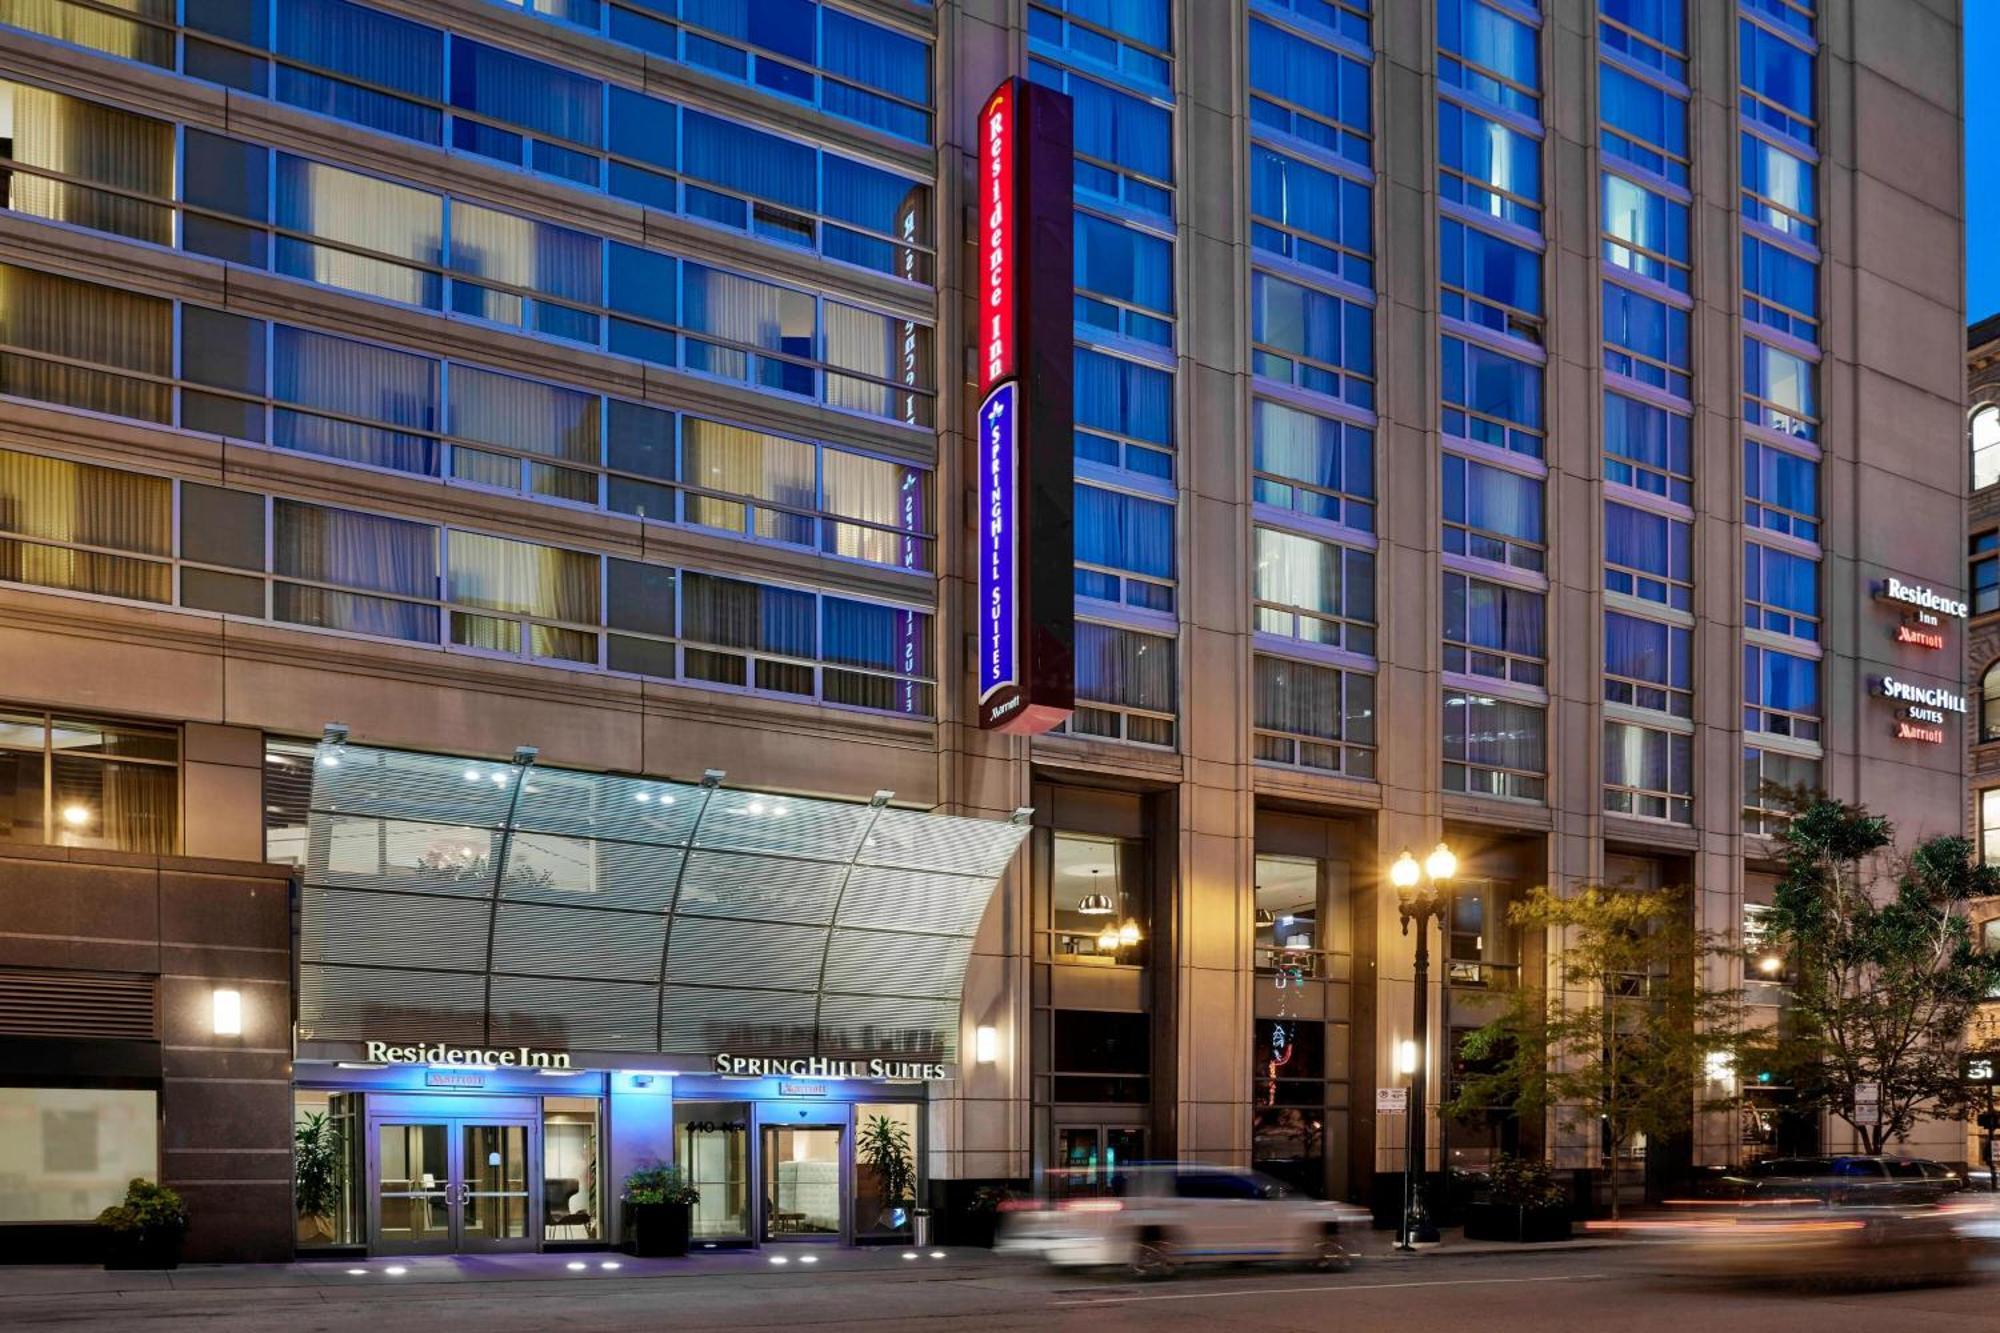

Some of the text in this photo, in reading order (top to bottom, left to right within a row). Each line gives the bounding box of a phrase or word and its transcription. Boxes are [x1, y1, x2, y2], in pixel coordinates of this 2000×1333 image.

[989, 112, 1003, 381] Residence Inn
[991, 425, 1002, 680] SPRINGHILL SUITES
[1888, 577, 1968, 618] Residence
[1919, 610, 1938, 626] Inn
[1898, 626, 1943, 649] Marriott
[989, 695, 1020, 722] Marriott
[1909, 706, 1944, 724] SUITES
[1898, 723, 1943, 744] Marriott
[366, 1041, 571, 1069] Residence Inn
[870, 1058, 945, 1080] SUITES
